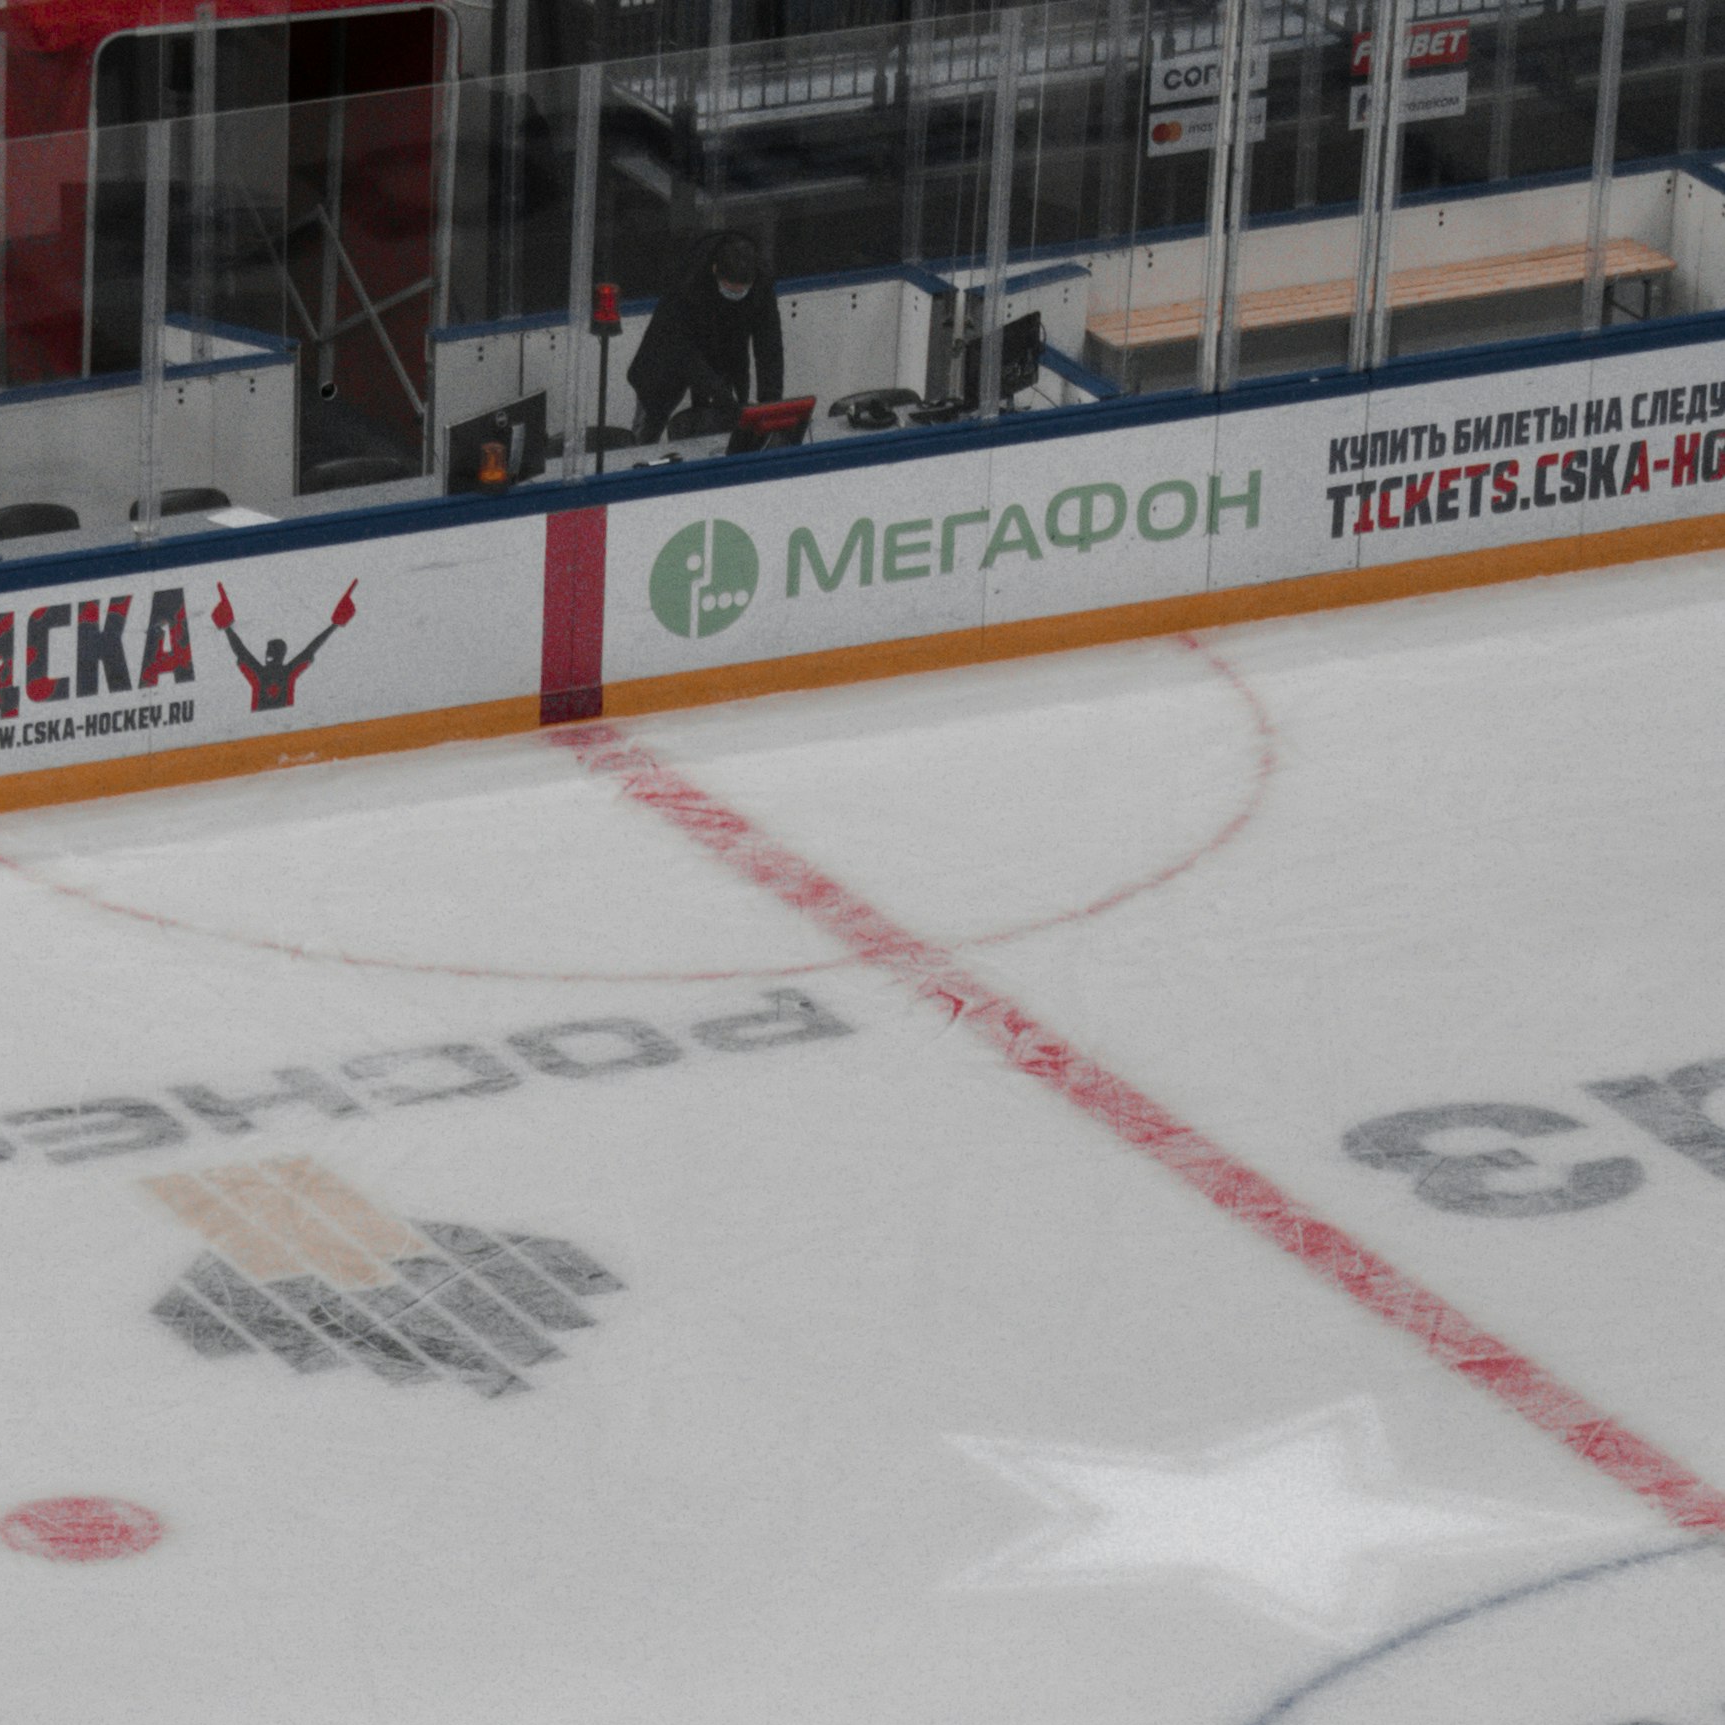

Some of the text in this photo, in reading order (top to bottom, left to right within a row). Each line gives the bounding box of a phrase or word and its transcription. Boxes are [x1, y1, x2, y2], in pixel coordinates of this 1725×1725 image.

[1354, 28, 1468, 67] FBET
[1328, 422, 1447, 475] КУПИТЬ
[1452, 402, 1578, 456] БИЛЕТЫ
[1583, 397, 1623, 437] НА
[785, 468, 1262, 599] МЕГАФОН
